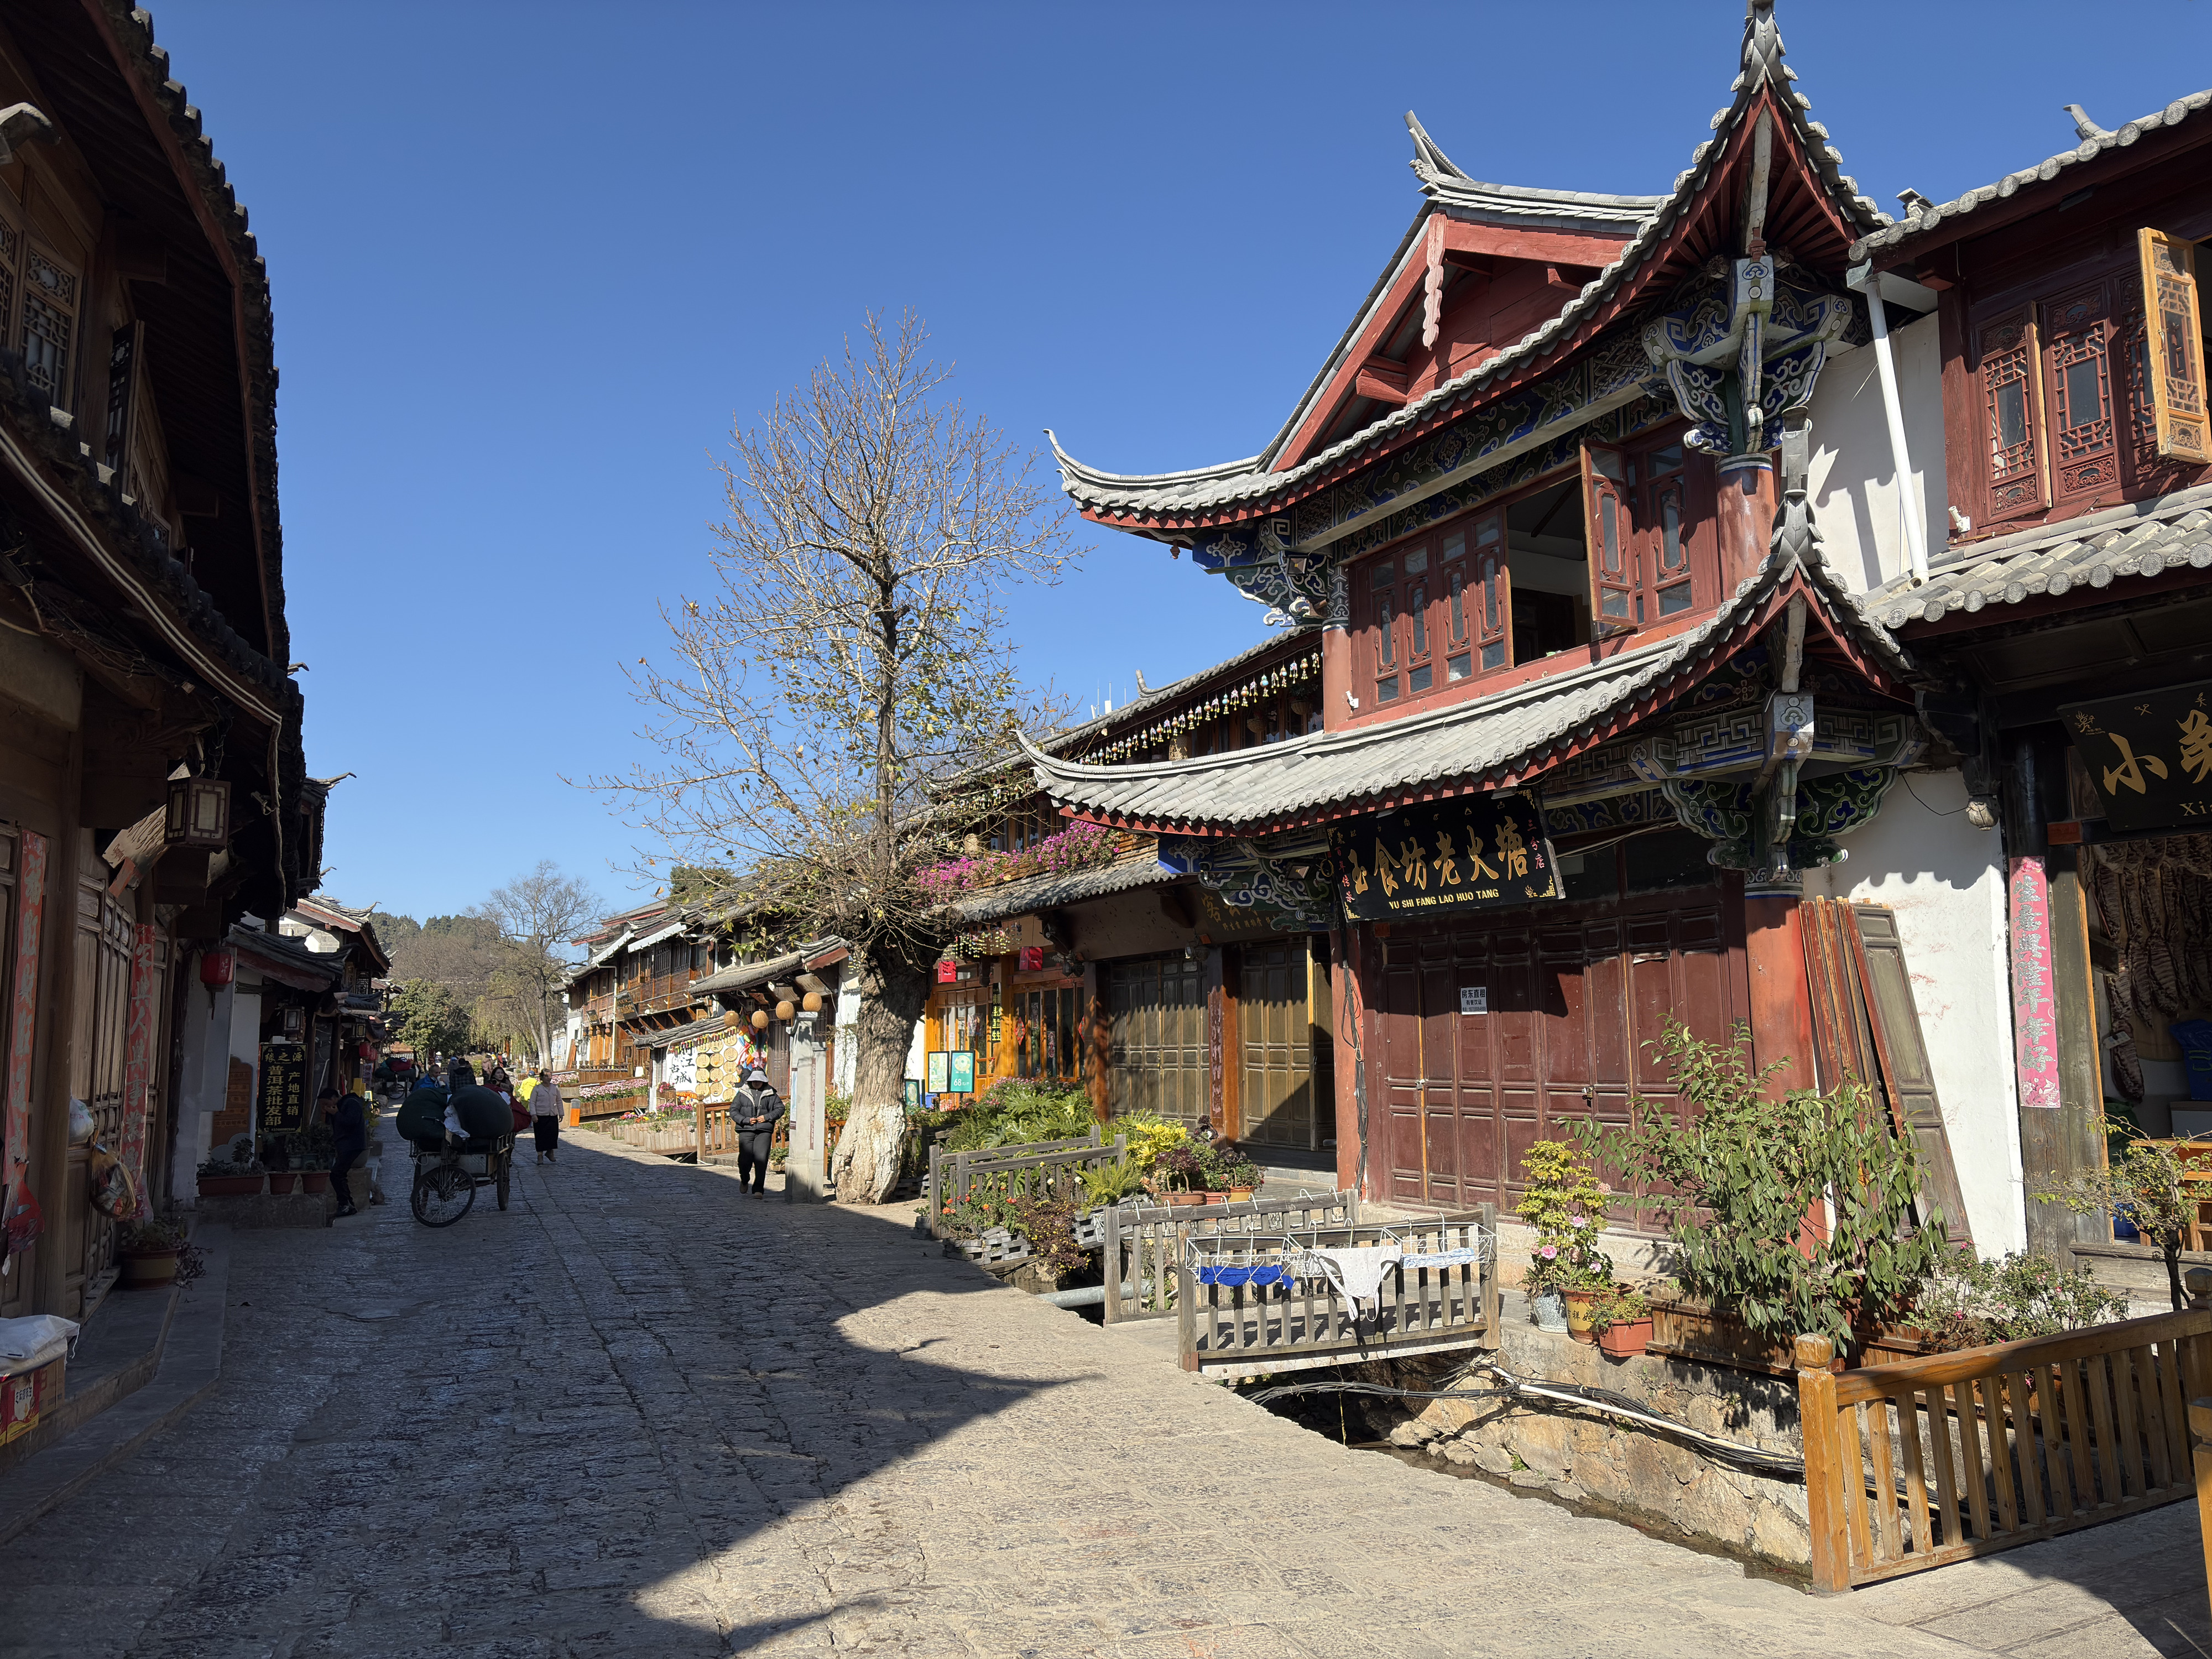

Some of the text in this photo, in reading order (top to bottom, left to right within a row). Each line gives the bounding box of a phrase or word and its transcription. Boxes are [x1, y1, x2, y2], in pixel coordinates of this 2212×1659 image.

[1527, 818, 1545, 869] 三分店
[1389, 888, 1500, 910] YU SHI FANG LAO HUO TANG
[1462, 989, 1485, 998] 房东直租
[264, 1065, 284, 1126] 普洱茶批发部
[286, 1072, 300, 1115] 产地直销
